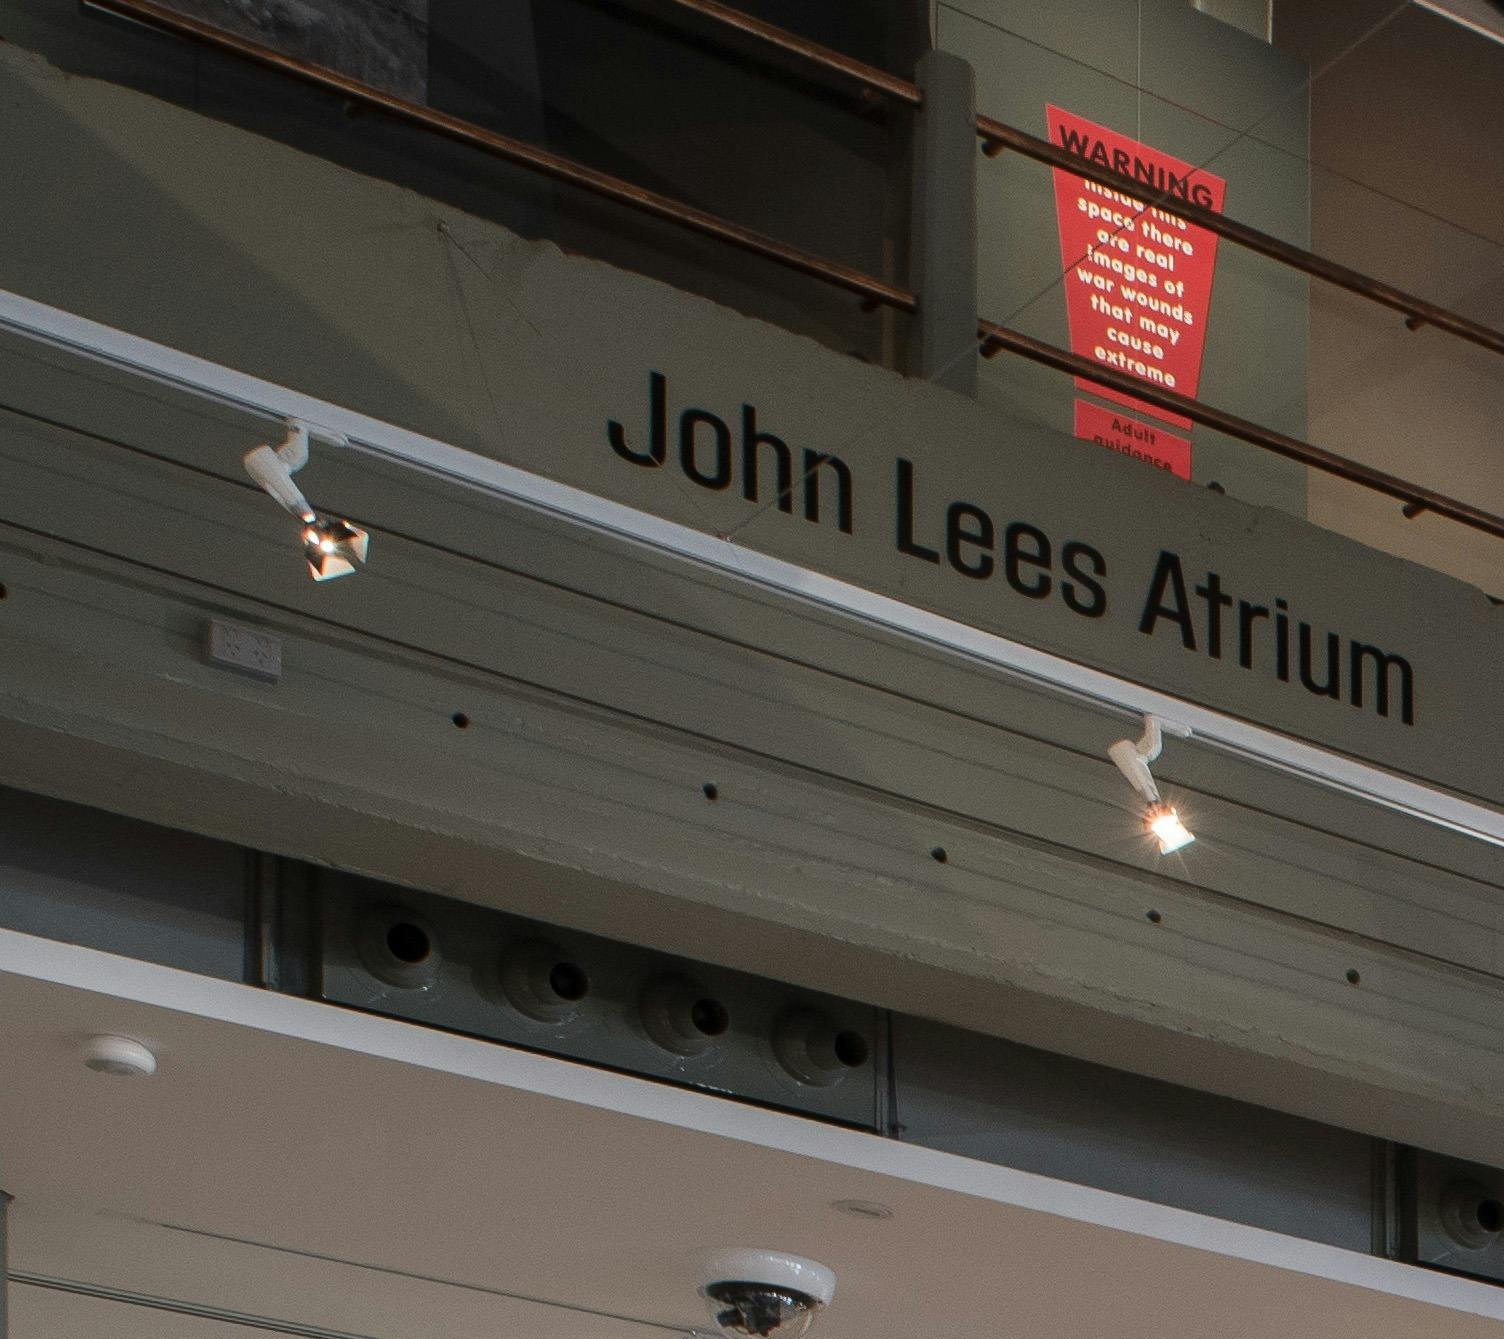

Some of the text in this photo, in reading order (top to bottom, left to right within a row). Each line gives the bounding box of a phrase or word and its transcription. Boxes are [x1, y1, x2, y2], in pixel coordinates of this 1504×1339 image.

[1059, 124, 1213, 210] WARNING
[1077, 196, 1193, 256] space there
[1097, 229, 1174, 272] are real
[1077, 267, 1193, 325] war wounds
[1088, 245, 1185, 299] images of
[1091, 295, 1180, 345] that may
[1106, 327, 1164, 360] cause
[1094, 346, 1176, 388] extreme
[1111, 418, 1156, 445] Adult
[606, 371, 1415, 727] John Lees Atrium
